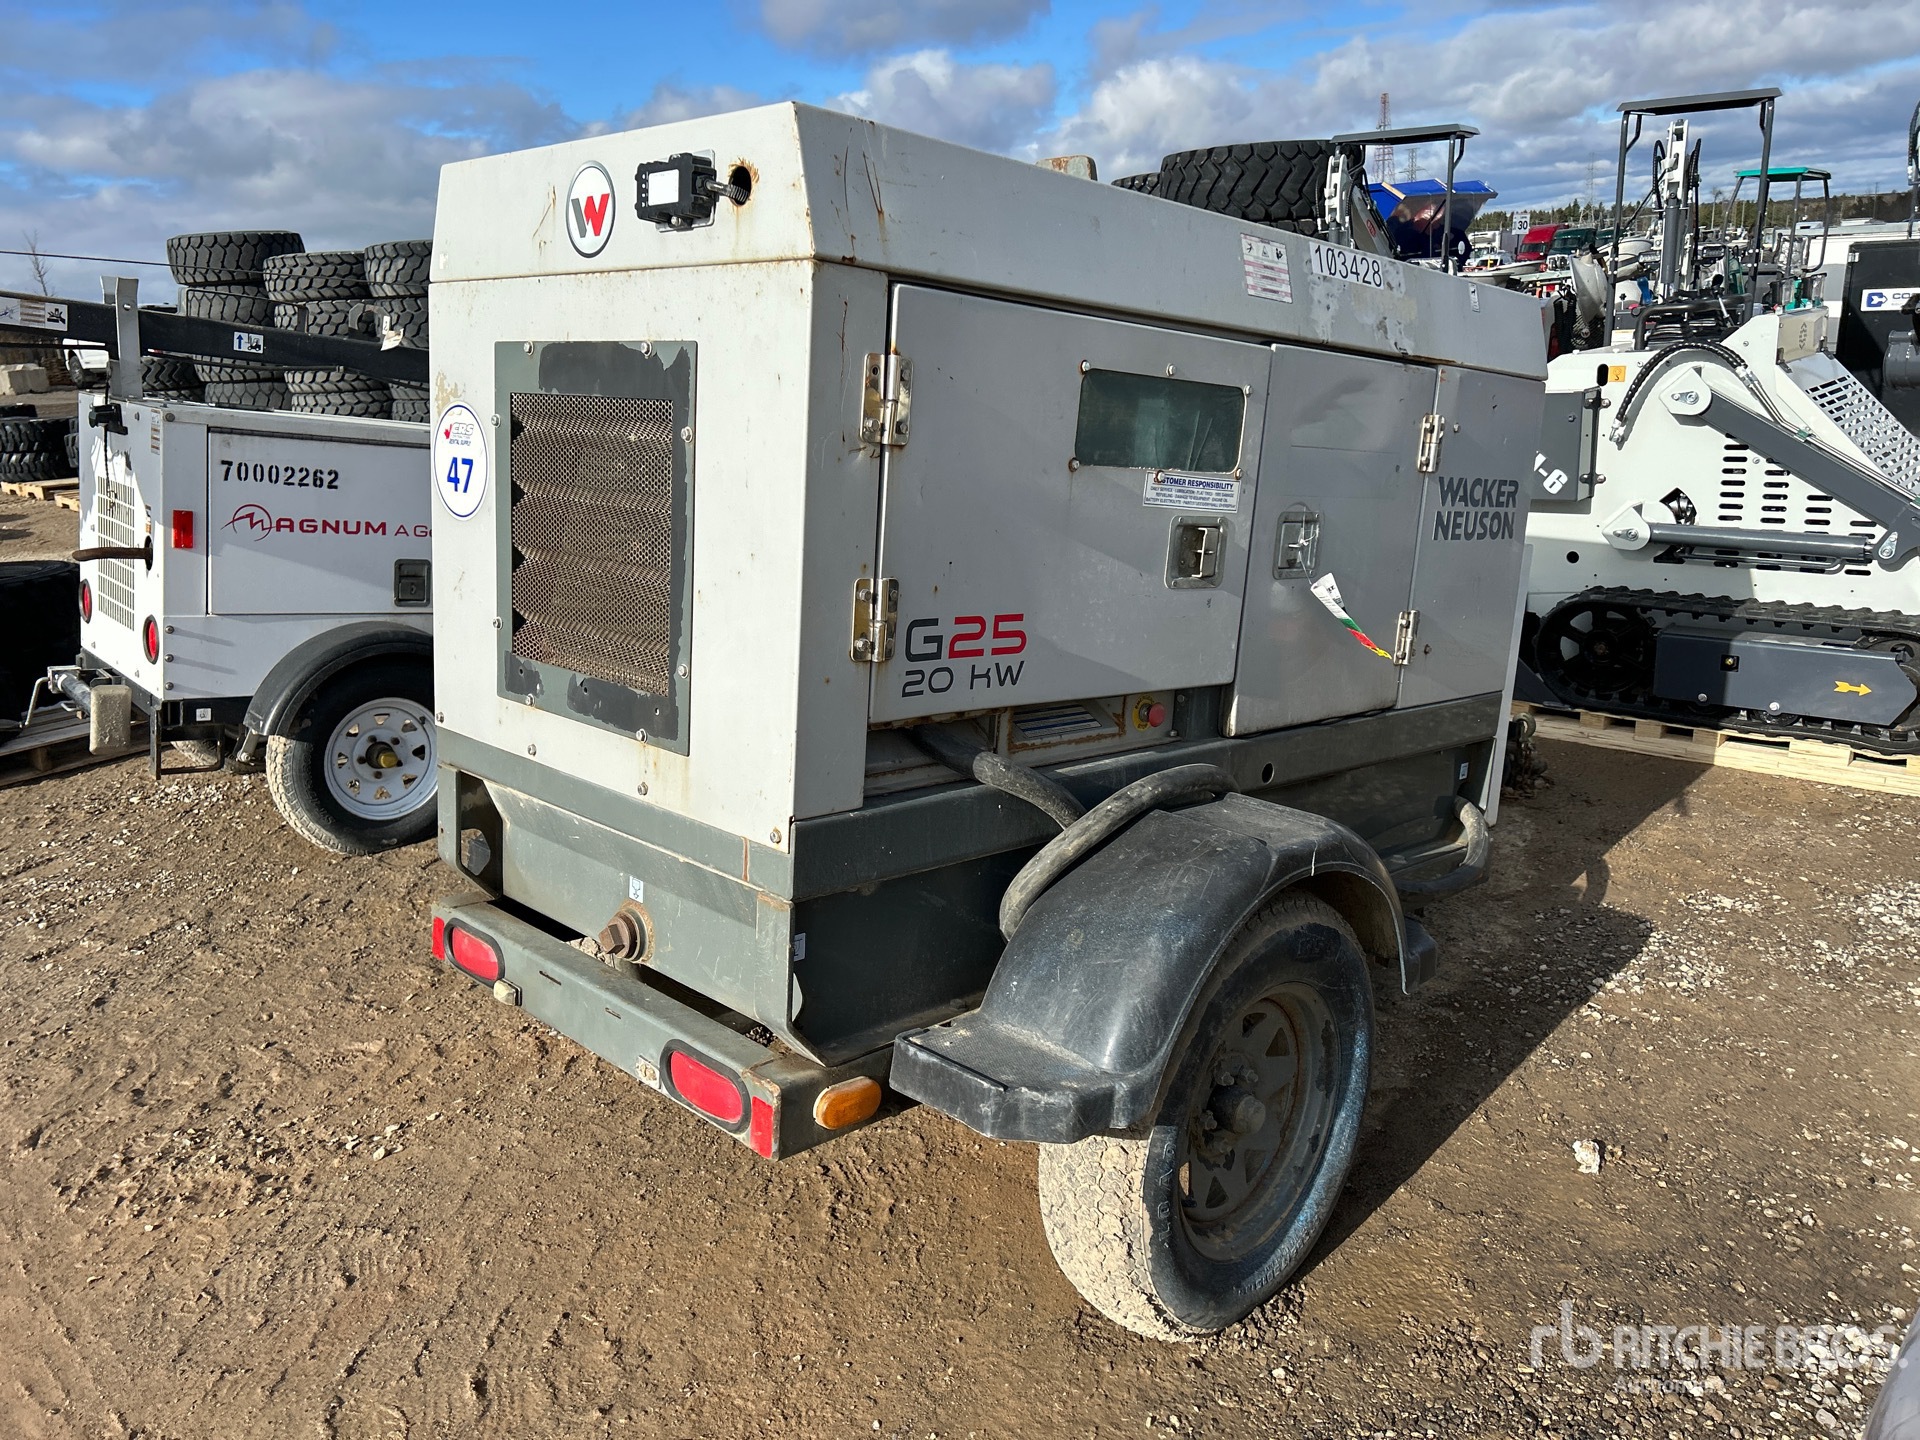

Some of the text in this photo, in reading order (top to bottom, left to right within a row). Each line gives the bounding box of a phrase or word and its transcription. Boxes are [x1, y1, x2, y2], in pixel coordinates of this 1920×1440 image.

[1518, 220, 1528, 230] 30
[1314, 244, 1383, 288] 103428
[220, 459, 339, 490] 70002262
[447, 456, 474, 493] 47
[1187, 479, 1234, 490] RESPONSIBILITY
[1438, 476, 1520, 508] WACKER
[1432, 510, 1516, 541] NEUSON
[905, 613, 1027, 663] G25
[902, 666, 954, 698] 20
